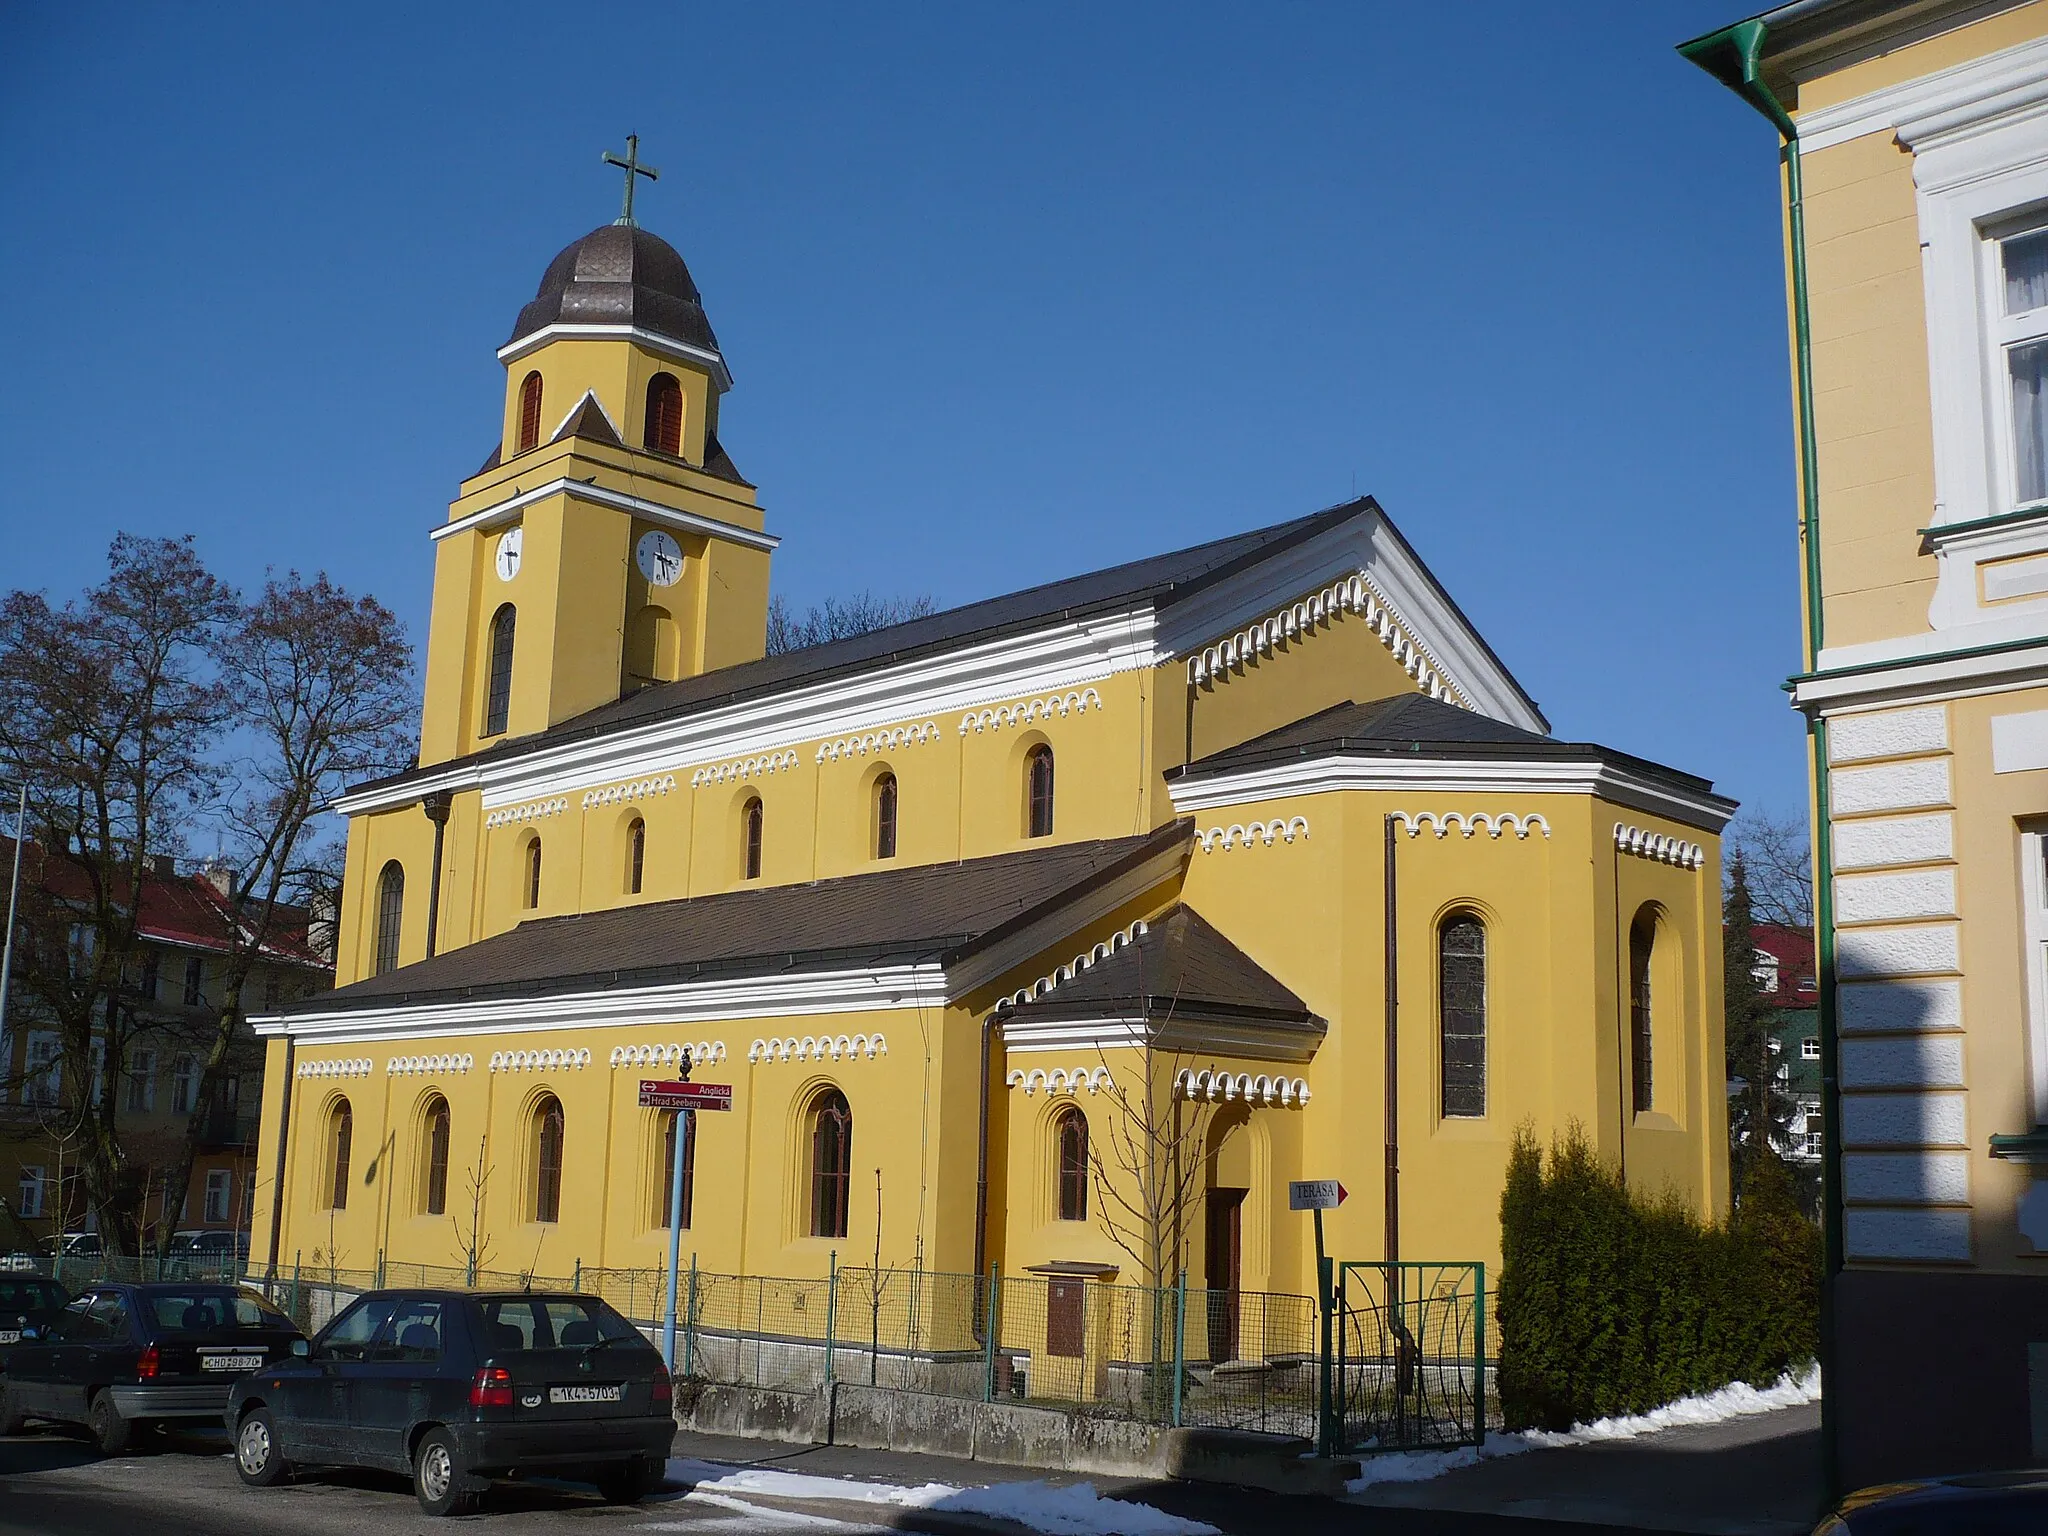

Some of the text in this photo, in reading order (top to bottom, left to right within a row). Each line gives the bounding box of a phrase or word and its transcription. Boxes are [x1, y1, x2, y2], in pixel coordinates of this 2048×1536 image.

[657, 534, 665, 543] 12
[699, 1085, 730, 1096] Anglická
[651, 1096, 702, 1108] Hrad Seeberg
[1296, 1183, 1335, 1199] TERASA
[588, 1386, 615, 1400] 5703
